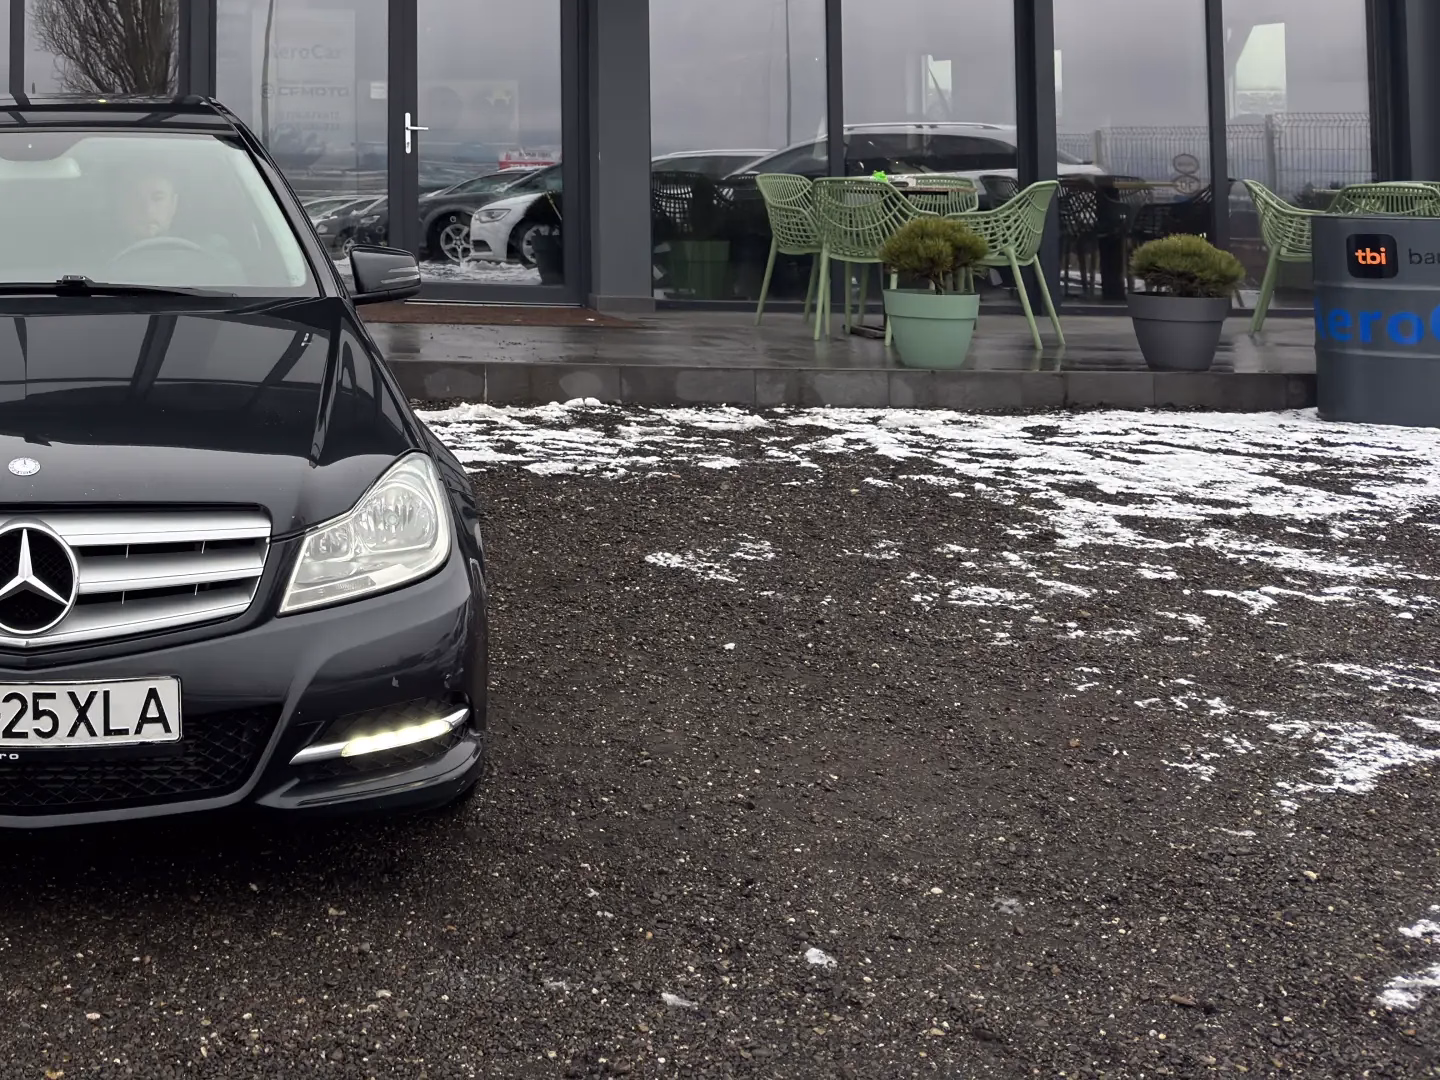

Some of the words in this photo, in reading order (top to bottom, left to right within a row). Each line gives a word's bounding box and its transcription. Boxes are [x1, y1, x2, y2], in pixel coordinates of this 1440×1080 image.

[1355, 247, 1387, 265] tbi
[1408, 248, 1440, 265] ba
[1314, 297, 1440, 346] ero
